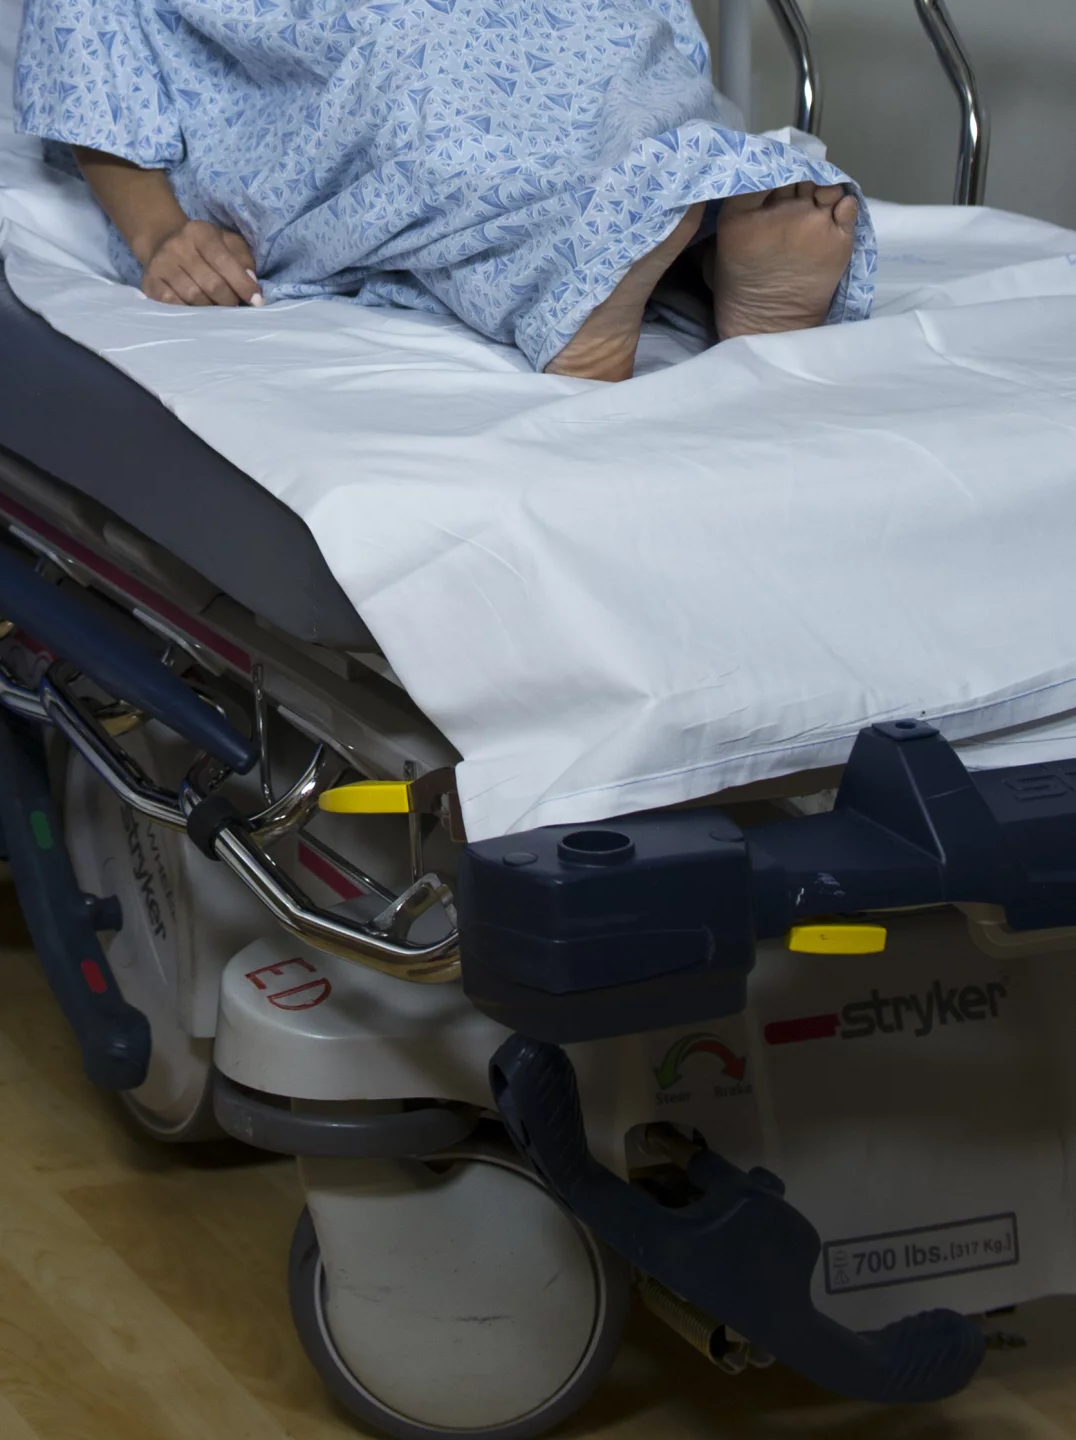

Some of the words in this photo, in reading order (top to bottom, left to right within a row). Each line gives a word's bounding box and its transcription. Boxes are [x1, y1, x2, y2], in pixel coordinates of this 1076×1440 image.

[245, 956, 333, 1011] ED
[840, 979, 1007, 1040] stryker
[852, 1248, 896, 1276] 700
[904, 1244, 948, 1269] lbs.
